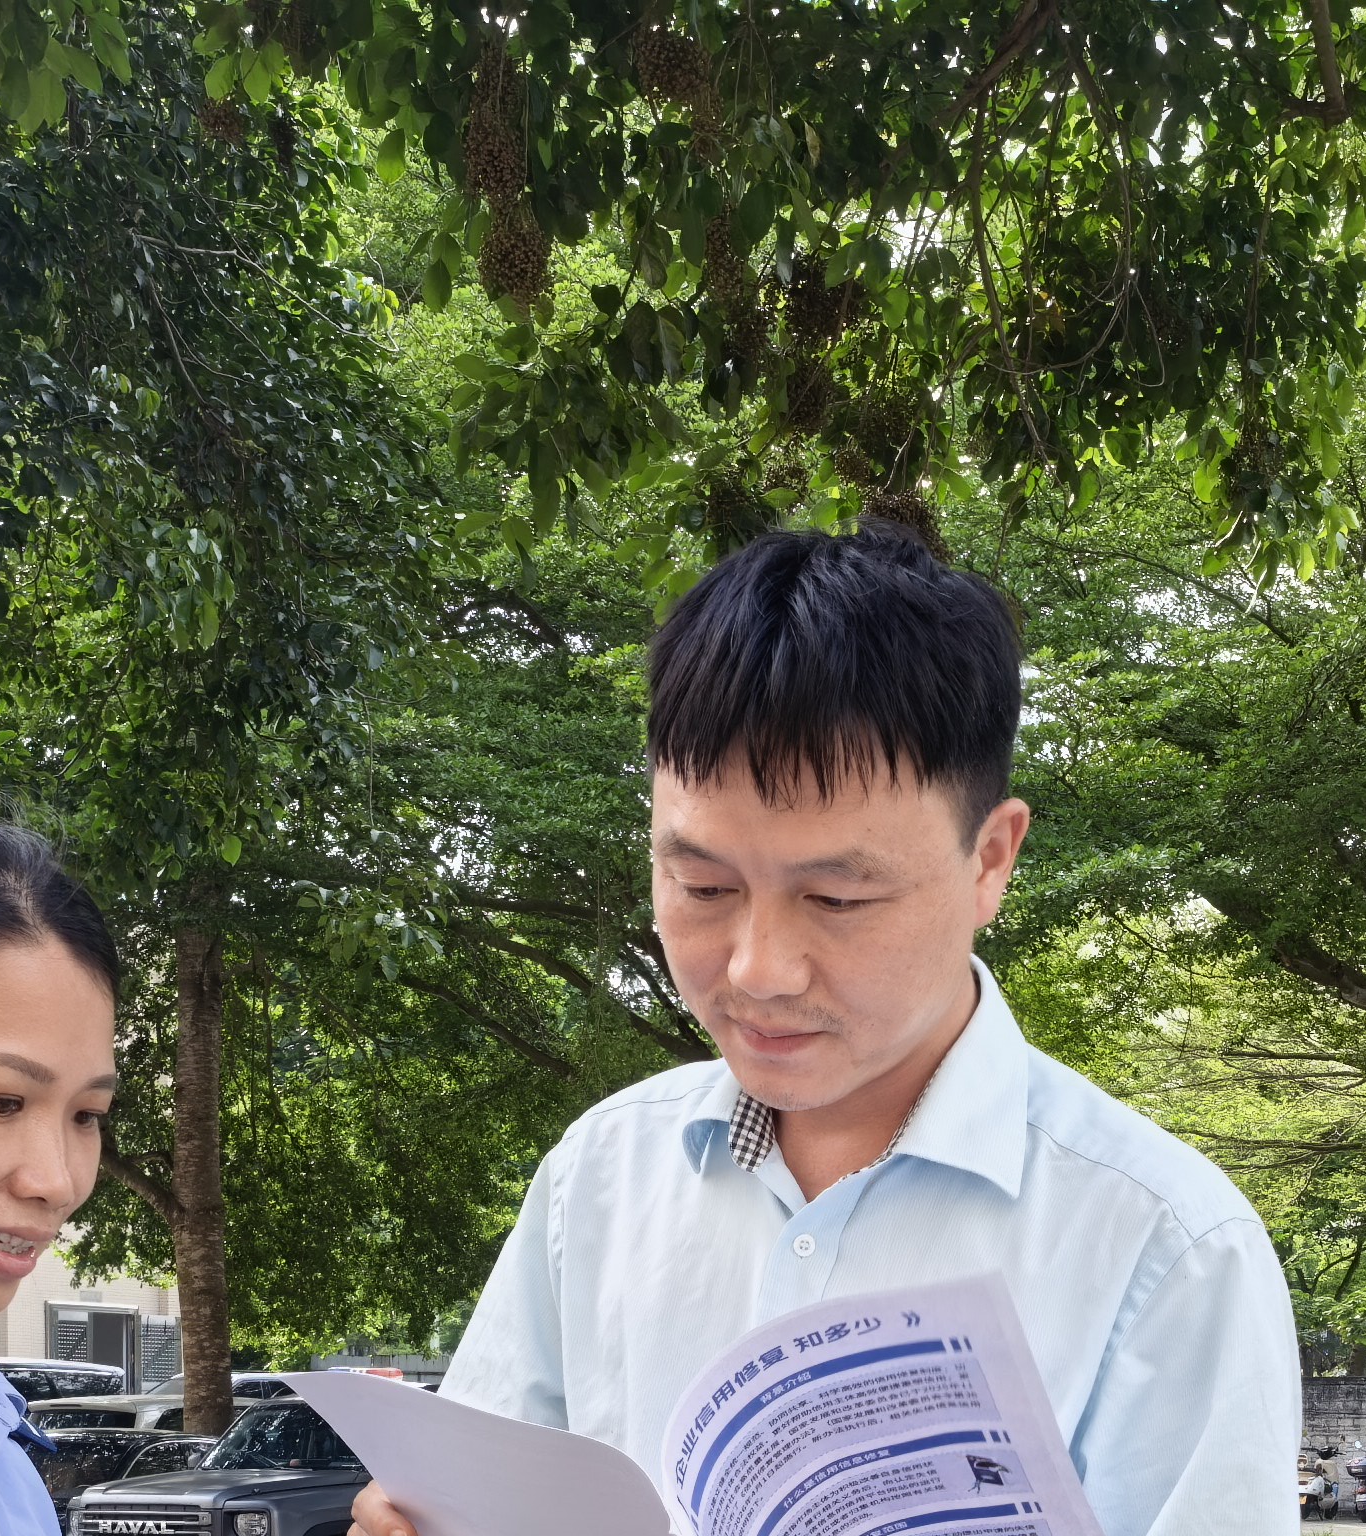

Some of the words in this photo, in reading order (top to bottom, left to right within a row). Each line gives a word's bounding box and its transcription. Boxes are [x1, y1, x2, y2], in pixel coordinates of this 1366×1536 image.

[676, 1345, 789, 1488] 企业信用修复
[793, 1317, 881, 1353] 知多少
[761, 1370, 812, 1405] 背景介绍
[98, 1519, 176, 1535] HAVAL
